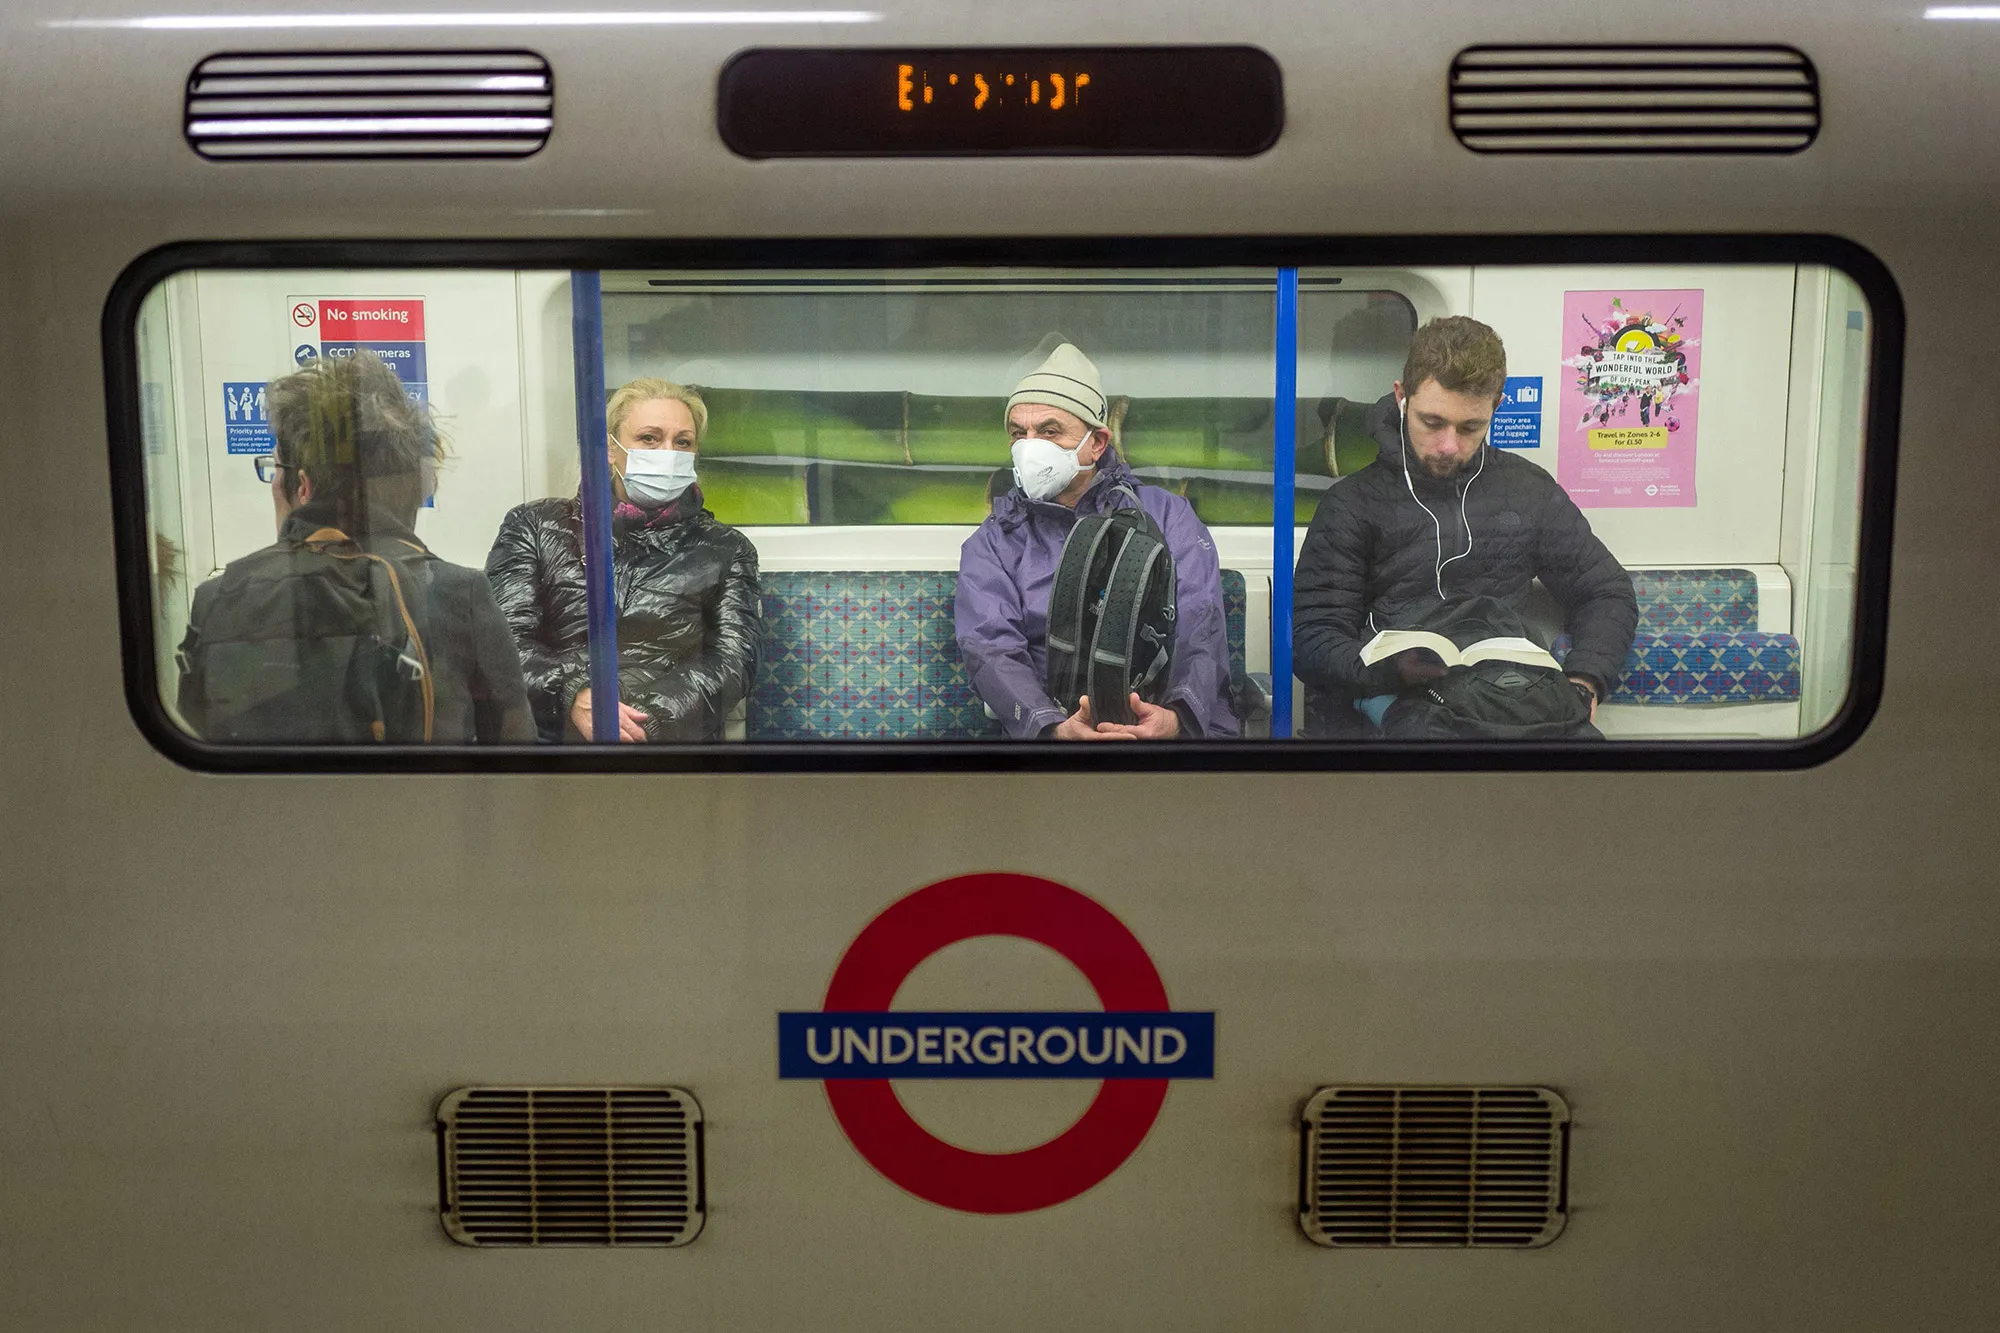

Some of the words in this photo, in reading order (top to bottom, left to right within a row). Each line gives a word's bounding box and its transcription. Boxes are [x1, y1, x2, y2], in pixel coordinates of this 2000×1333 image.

[327, 308, 348, 320] No
[352, 308, 409, 323] smoking
[1644, 356, 1657, 364] THE
[1596, 364, 1642, 374] WONDERFUL
[1645, 365, 1673, 375] WORLD
[229, 427, 253, 435] Priority
[806, 1026, 1188, 1066] UNDERGROUND
